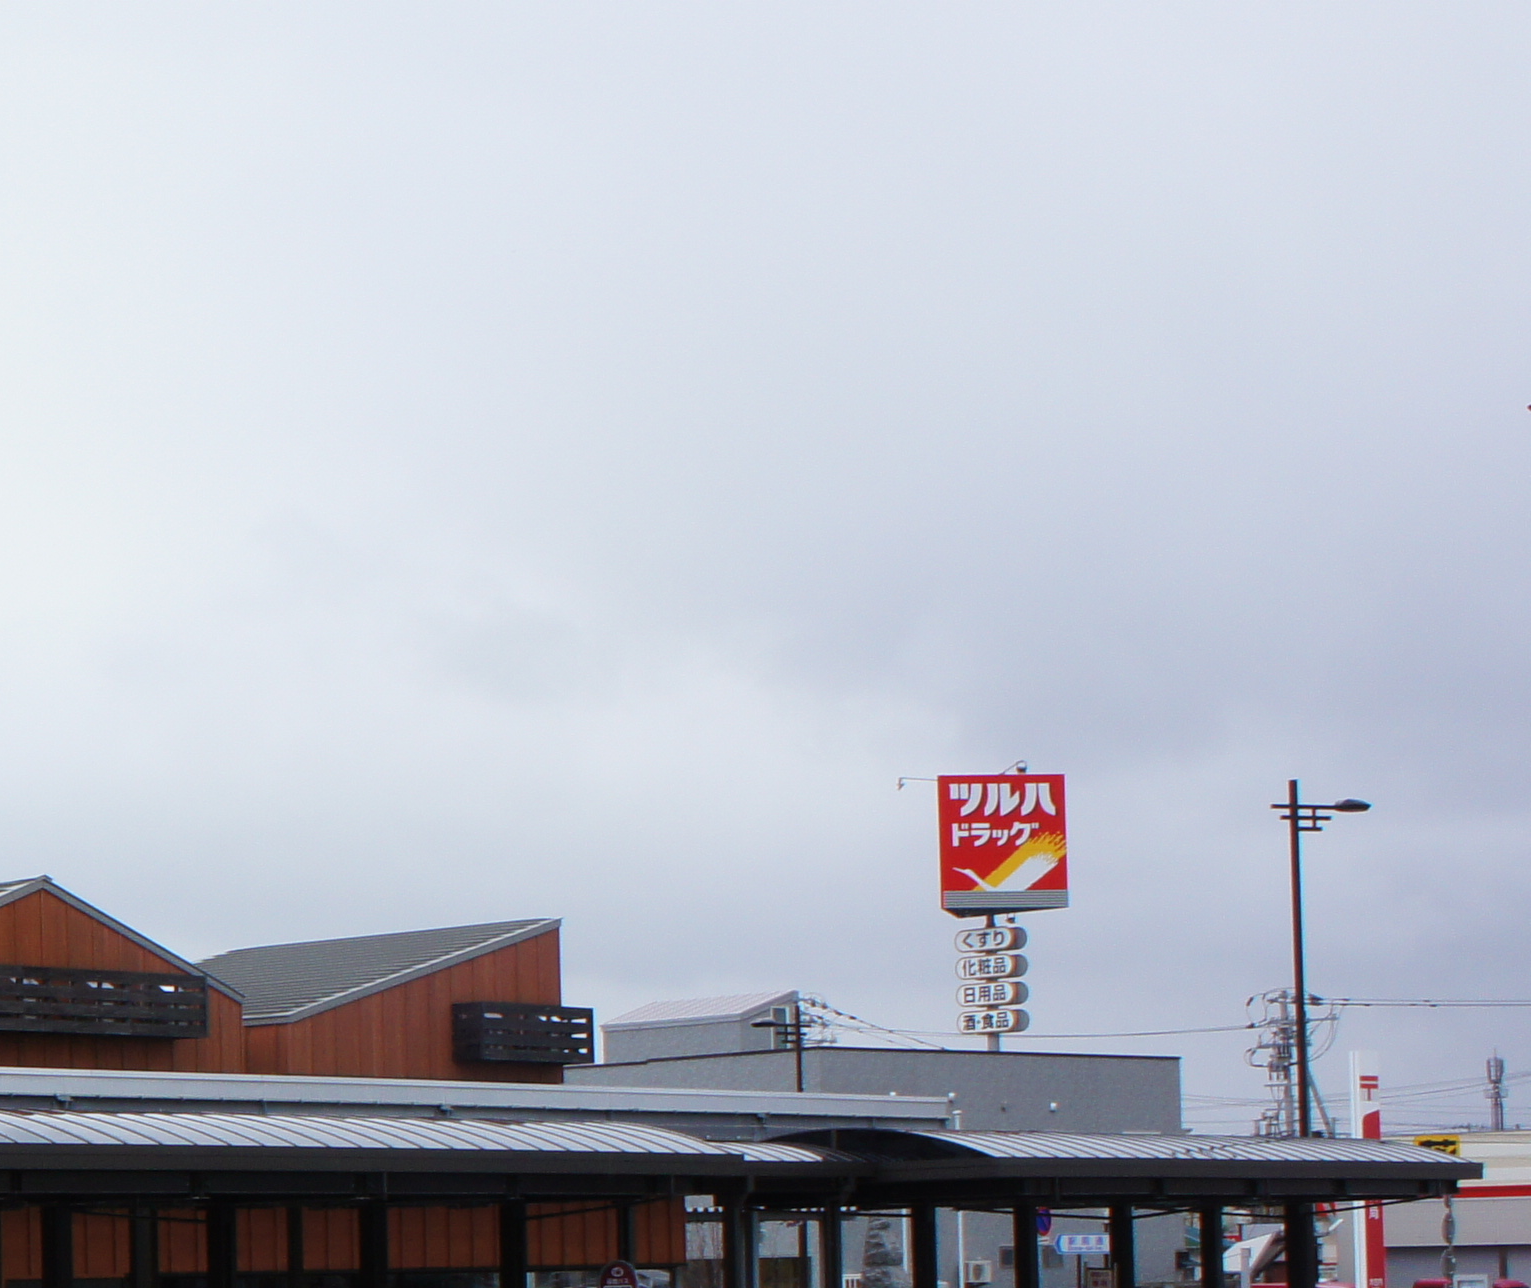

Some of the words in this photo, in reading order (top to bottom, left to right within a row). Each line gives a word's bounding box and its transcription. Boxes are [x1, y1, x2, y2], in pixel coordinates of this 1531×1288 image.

[949, 783, 1057, 816] ツルハ
[952, 821, 1040, 847] ドラッグ
[961, 929, 1006, 948] くすり
[962, 956, 1006, 977] 化粧品
[962, 984, 1006, 1004] 日用品
